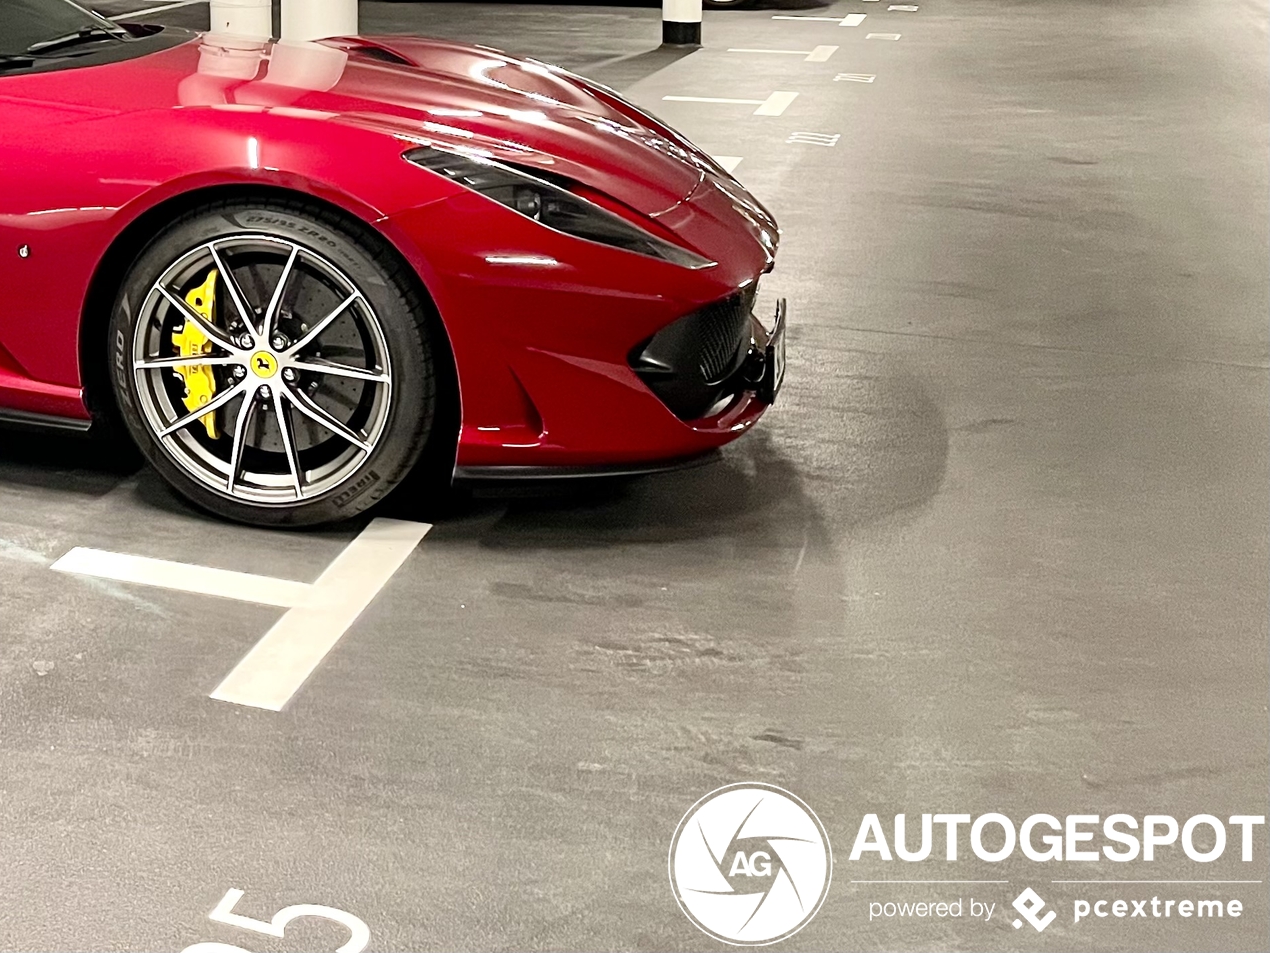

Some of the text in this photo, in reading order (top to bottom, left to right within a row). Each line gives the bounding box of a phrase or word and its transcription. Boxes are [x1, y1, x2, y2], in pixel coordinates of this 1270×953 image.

[115, 329, 133, 408] ZERO
[331, 469, 381, 508] PIRELLI
[180, 886, 371, 953] 5
